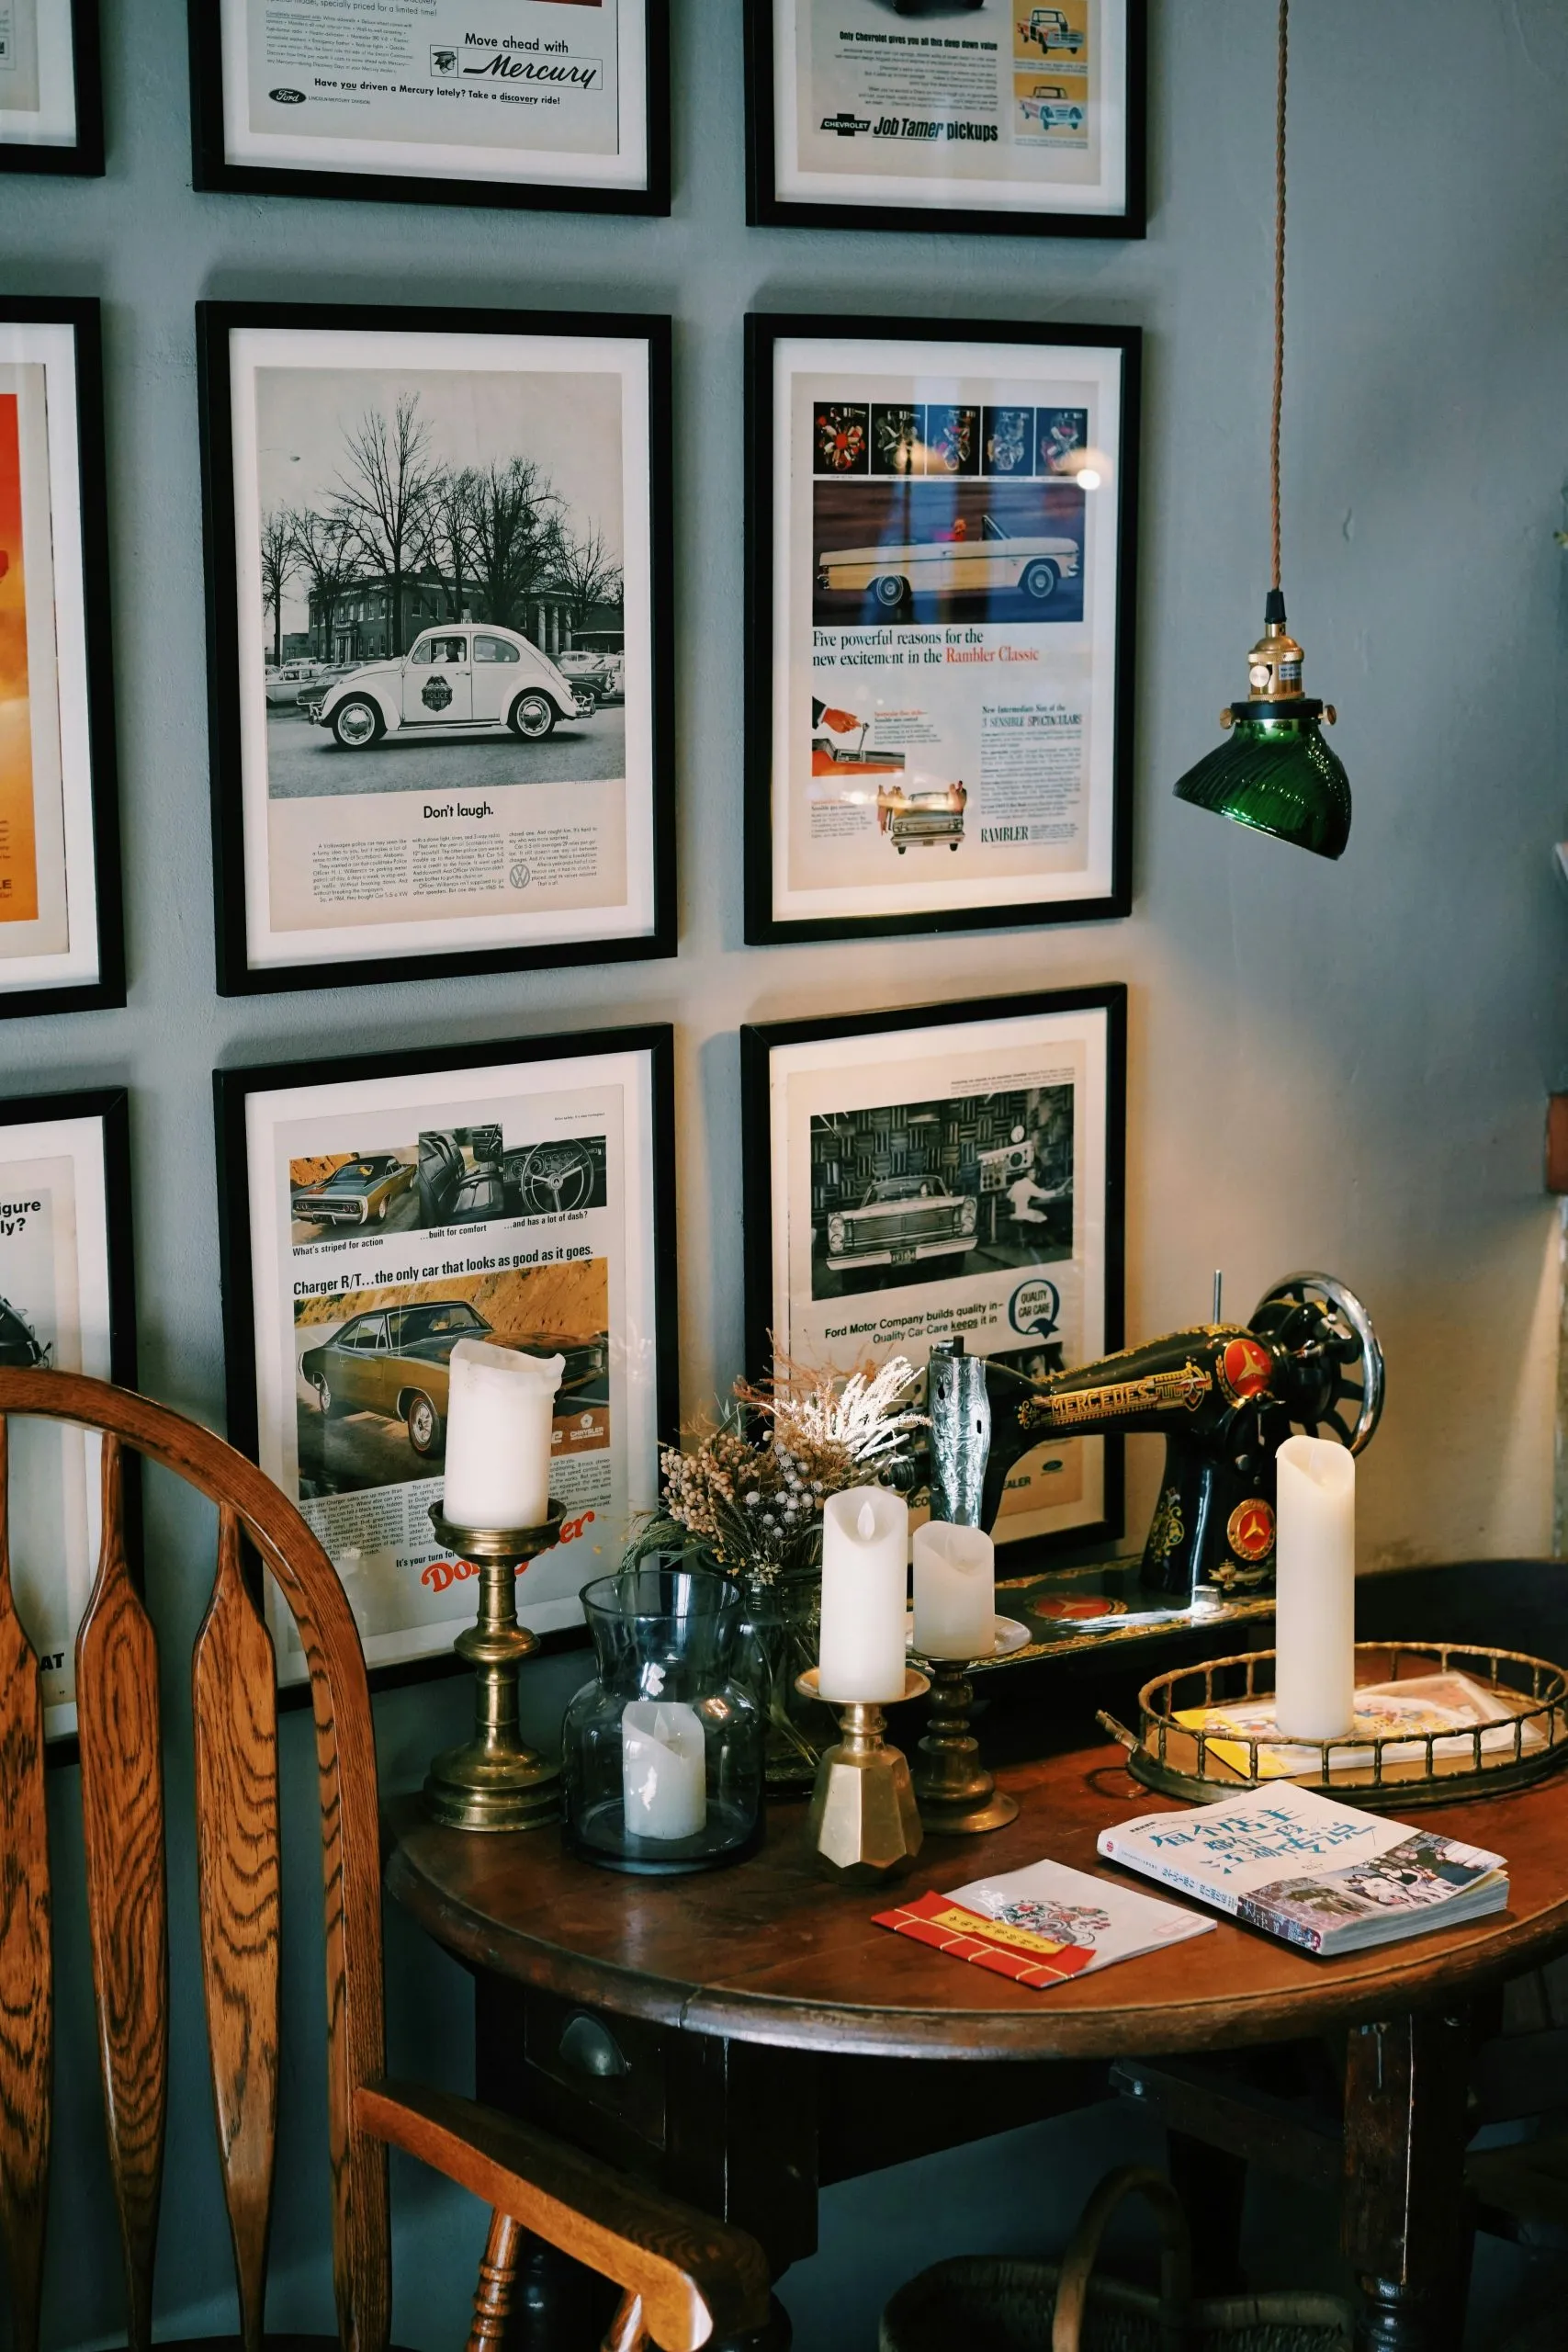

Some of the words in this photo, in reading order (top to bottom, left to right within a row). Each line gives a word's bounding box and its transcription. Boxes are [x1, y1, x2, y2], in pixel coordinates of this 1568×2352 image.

[321, 1, 351, 10] specially
[353, 3, 376, 13] priced
[378, 5, 387, 13] for
[397, 6, 420, 16] limited
[422, 8, 437, 17] time!
[465, 33, 498, 47] Move
[502, 36, 539, 51] ahead
[544, 40, 569, 53] with
[840, 31, 854, 41] Only
[856, 31, 887, 43] Chevrolet
[888, 34, 906, 46] gives
[908, 38, 919, 46] you
[920, 37, 929, 46] all
[931, 37, 942, 47] this
[944, 39, 960, 50] deep
[961, 40, 979, 50] down
[980, 40, 998, 51] value
[463, 54, 597, 89] Mercury
[276, 90, 299, 102] Ford
[314, 78, 337, 87] Have
[360, 82, 388, 92] driven
[399, 85, 434, 96] Mercury
[437, 87, 466, 98] lately?
[468, 90, 489, 100] Take
[500, 93, 538, 104] discovery
[542, 96, 560, 105] ride!
[823, 120, 869, 129] CHEVROLET
[874, 117, 900, 136] Job
[902, 119, 943, 138] Tamer
[946, 121, 998, 142] pickups
[813, 630, 836, 646] Five
[840, 629, 893, 649] powerful
[897, 633, 942, 646] reasons
[945, 628, 962, 644] for
[964, 628, 983, 644] the
[813, 654, 836, 666] new
[840, 650, 904, 665] excitement
[908, 649, 919, 663] in
[923, 648, 942, 663] the
[946, 647, 996, 662] Rambler
[998, 645, 1039, 662] Classic
[990, 717, 1023, 728] SENSIBLE
[423, 805, 454, 819] Don't
[457, 801, 494, 819] laugh.
[981, 825, 1029, 843] RAMBLER
[504, 1219, 525, 1229] ...and
[527, 1217, 540, 1226] has
[547, 1215, 557, 1224] lot
[558, 1214, 566, 1222] of
[568, 1211, 588, 1222] dash?
[420, 1229, 445, 1240] ...built
[446, 1227, 457, 1237] for
[459, 1224, 487, 1235] comfort
[293, 1246, 319, 1257] What's
[321, 1242, 347, 1255] striped
[349, 1240, 359, 1250] for
[361, 1238, 384, 1249] action
[294, 1278, 338, 1295] Charger
[396, 1267, 419, 1284] only
[423, 1268, 439, 1277] car
[442, 1261, 464, 1274] that
[467, 1257, 496, 1272] looks
[498, 1258, 511, 1266] as
[513, 1251, 539, 1266] good
[542, 1251, 554, 1261] as
[557, 1247, 564, 1259] it
[567, 1246, 593, 1261] goes.
[1021, 1290, 1048, 1305] QUALITY
[1018, 1305, 1032, 1318] CAR
[1032, 1301, 1051, 1317] CARE
[825, 1327, 847, 1339] Ford
[850, 1322, 876, 1335] Motor
[880, 1315, 924, 1332] Company
[926, 1308, 953, 1322] builds
[956, 1305, 987, 1319] quality
[873, 1330, 905, 1345] Quality
[908, 1328, 924, 1339] Car
[926, 1323, 949, 1335] Care
[951, 1319, 979, 1332] keeps
[981, 1316, 987, 1326] it
[988, 1315, 998, 1324] in
[1051, 1383, 1150, 1418] MERCEDES
[397, 1558, 408, 1569] It's
[410, 1555, 426, 1567] your
[428, 1553, 443, 1563] turn
[1148, 1807, 1306, 1848] 每个店主
